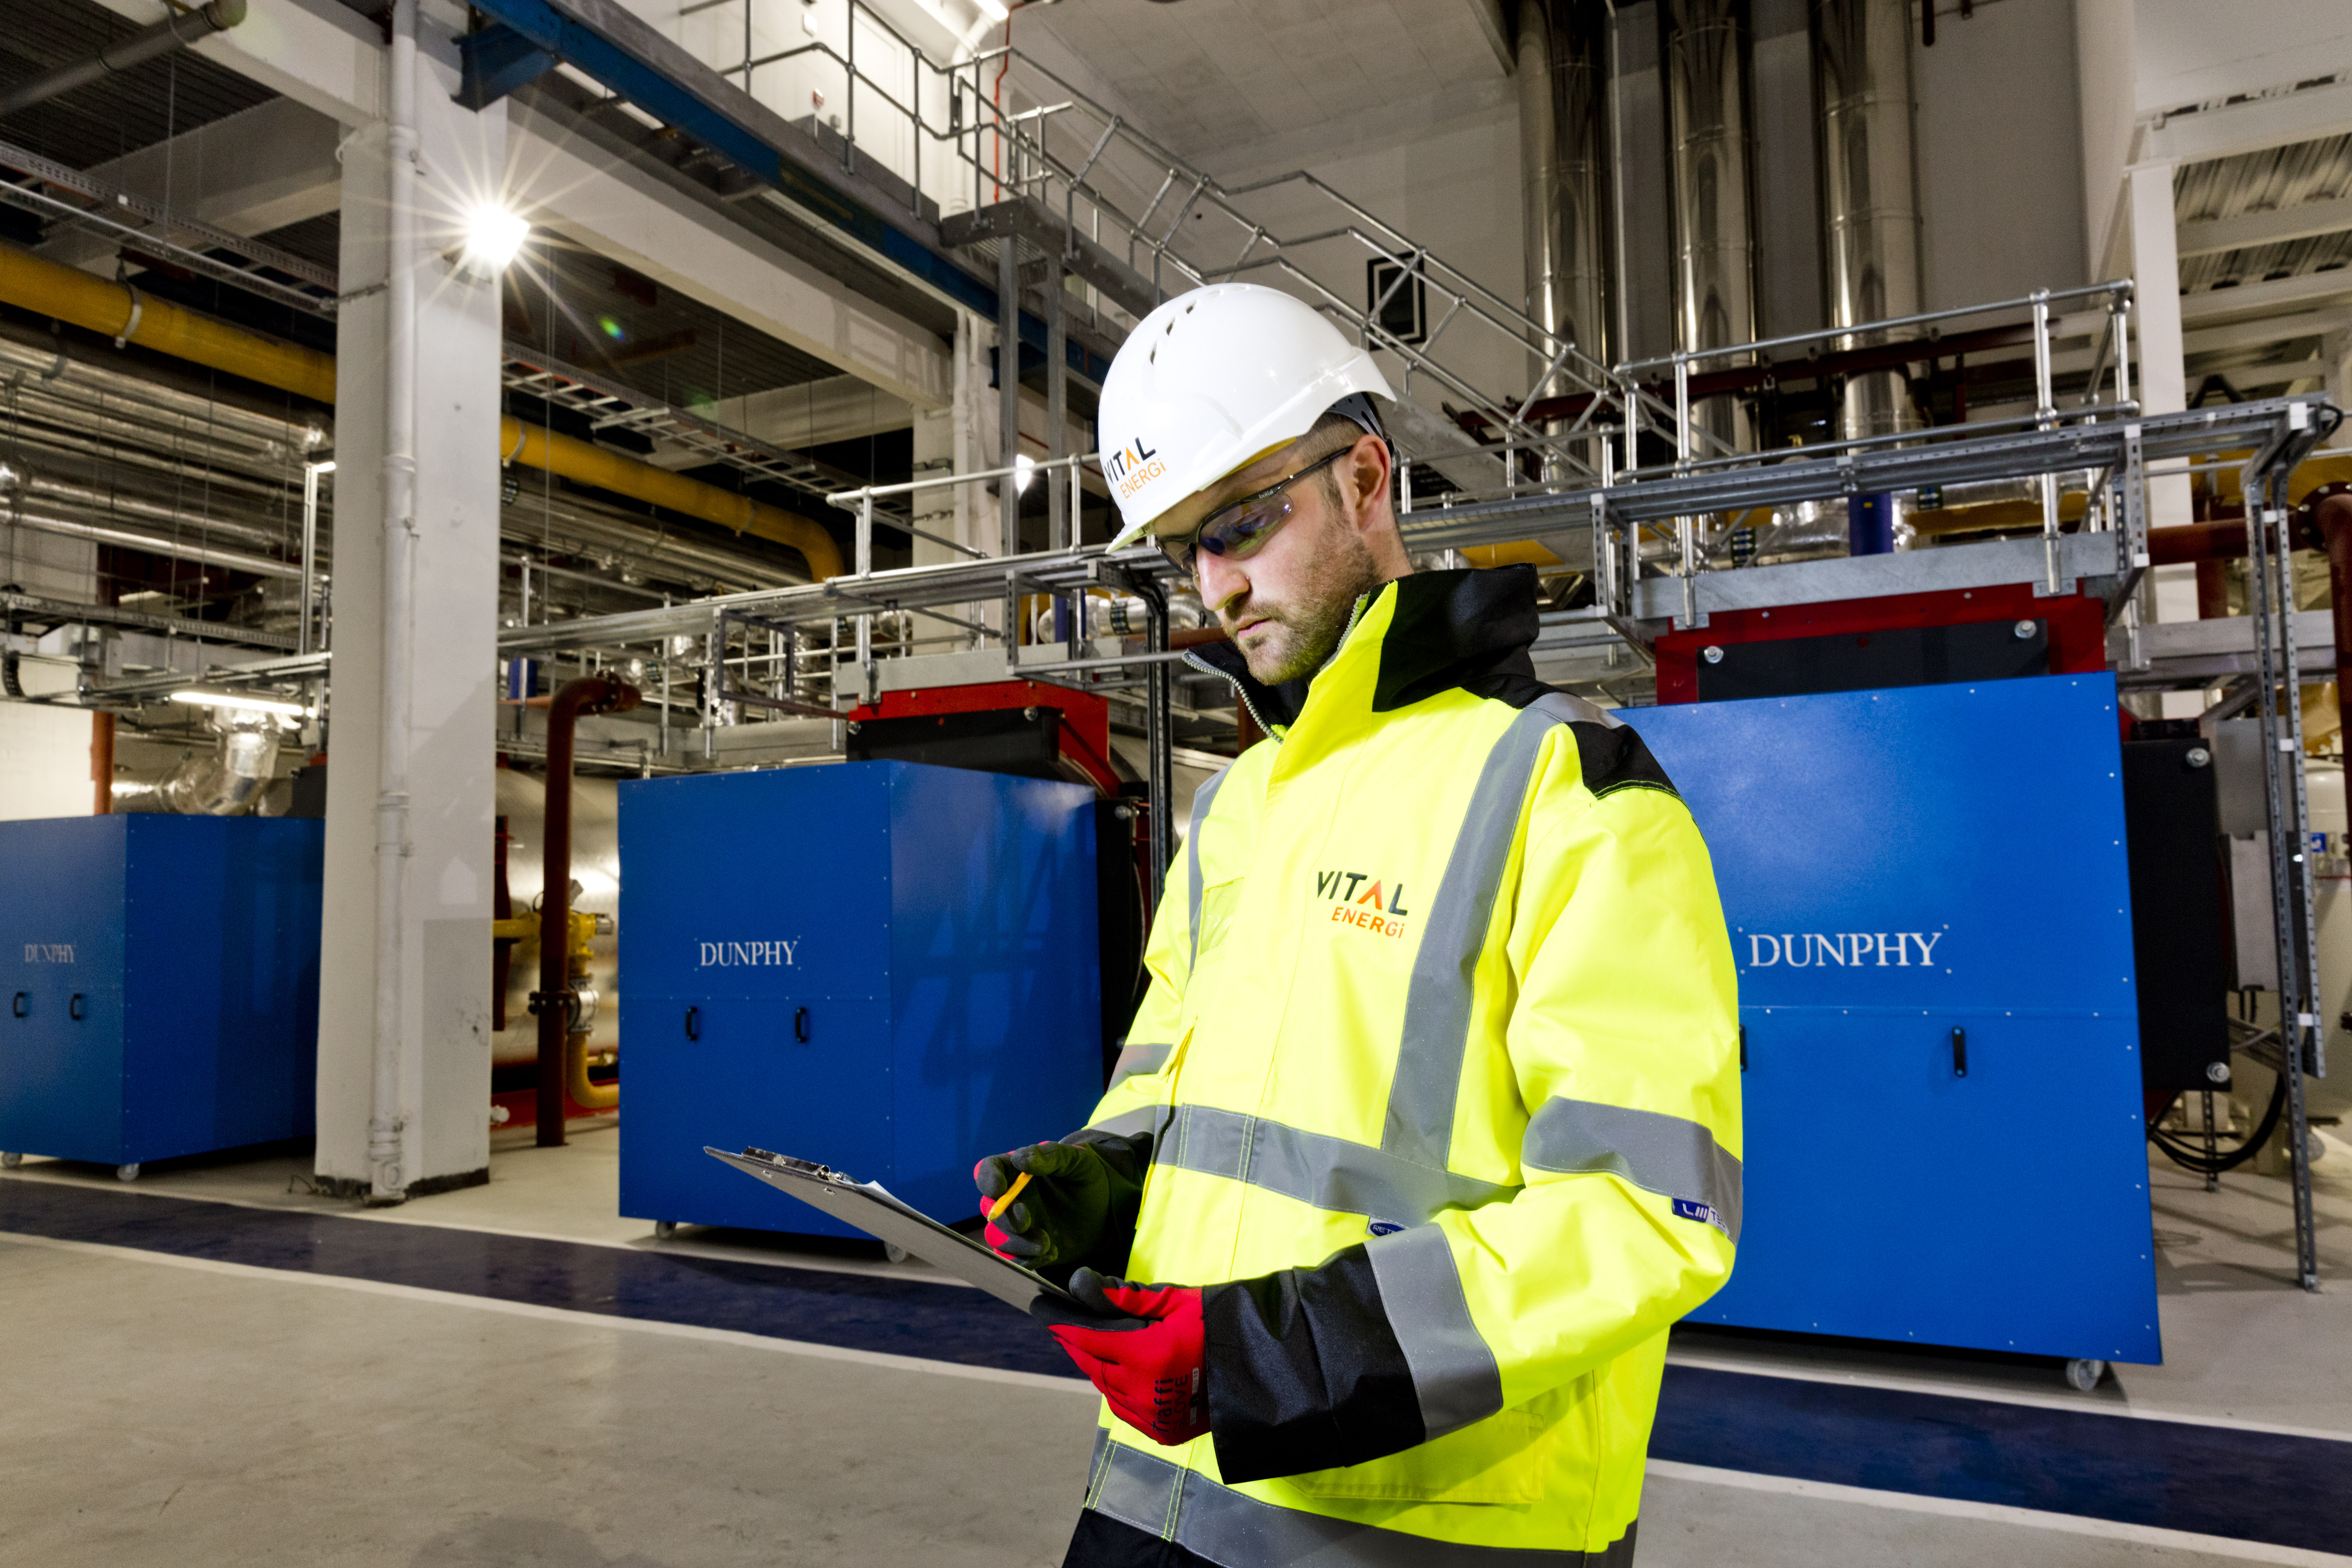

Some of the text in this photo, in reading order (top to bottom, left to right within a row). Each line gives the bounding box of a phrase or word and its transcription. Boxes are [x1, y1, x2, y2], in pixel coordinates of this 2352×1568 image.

[1104, 436, 1156, 485] VITAL
[1317, 871, 1408, 916] VITAL
[25, 944, 74, 963] DUNPHY
[700, 940, 798, 967] DUNPHY
[1747, 932, 1943, 968] DUNPHY
[1152, 1378, 1174, 1434] Traffi
[1172, 1374, 1187, 1434] GLOVE
